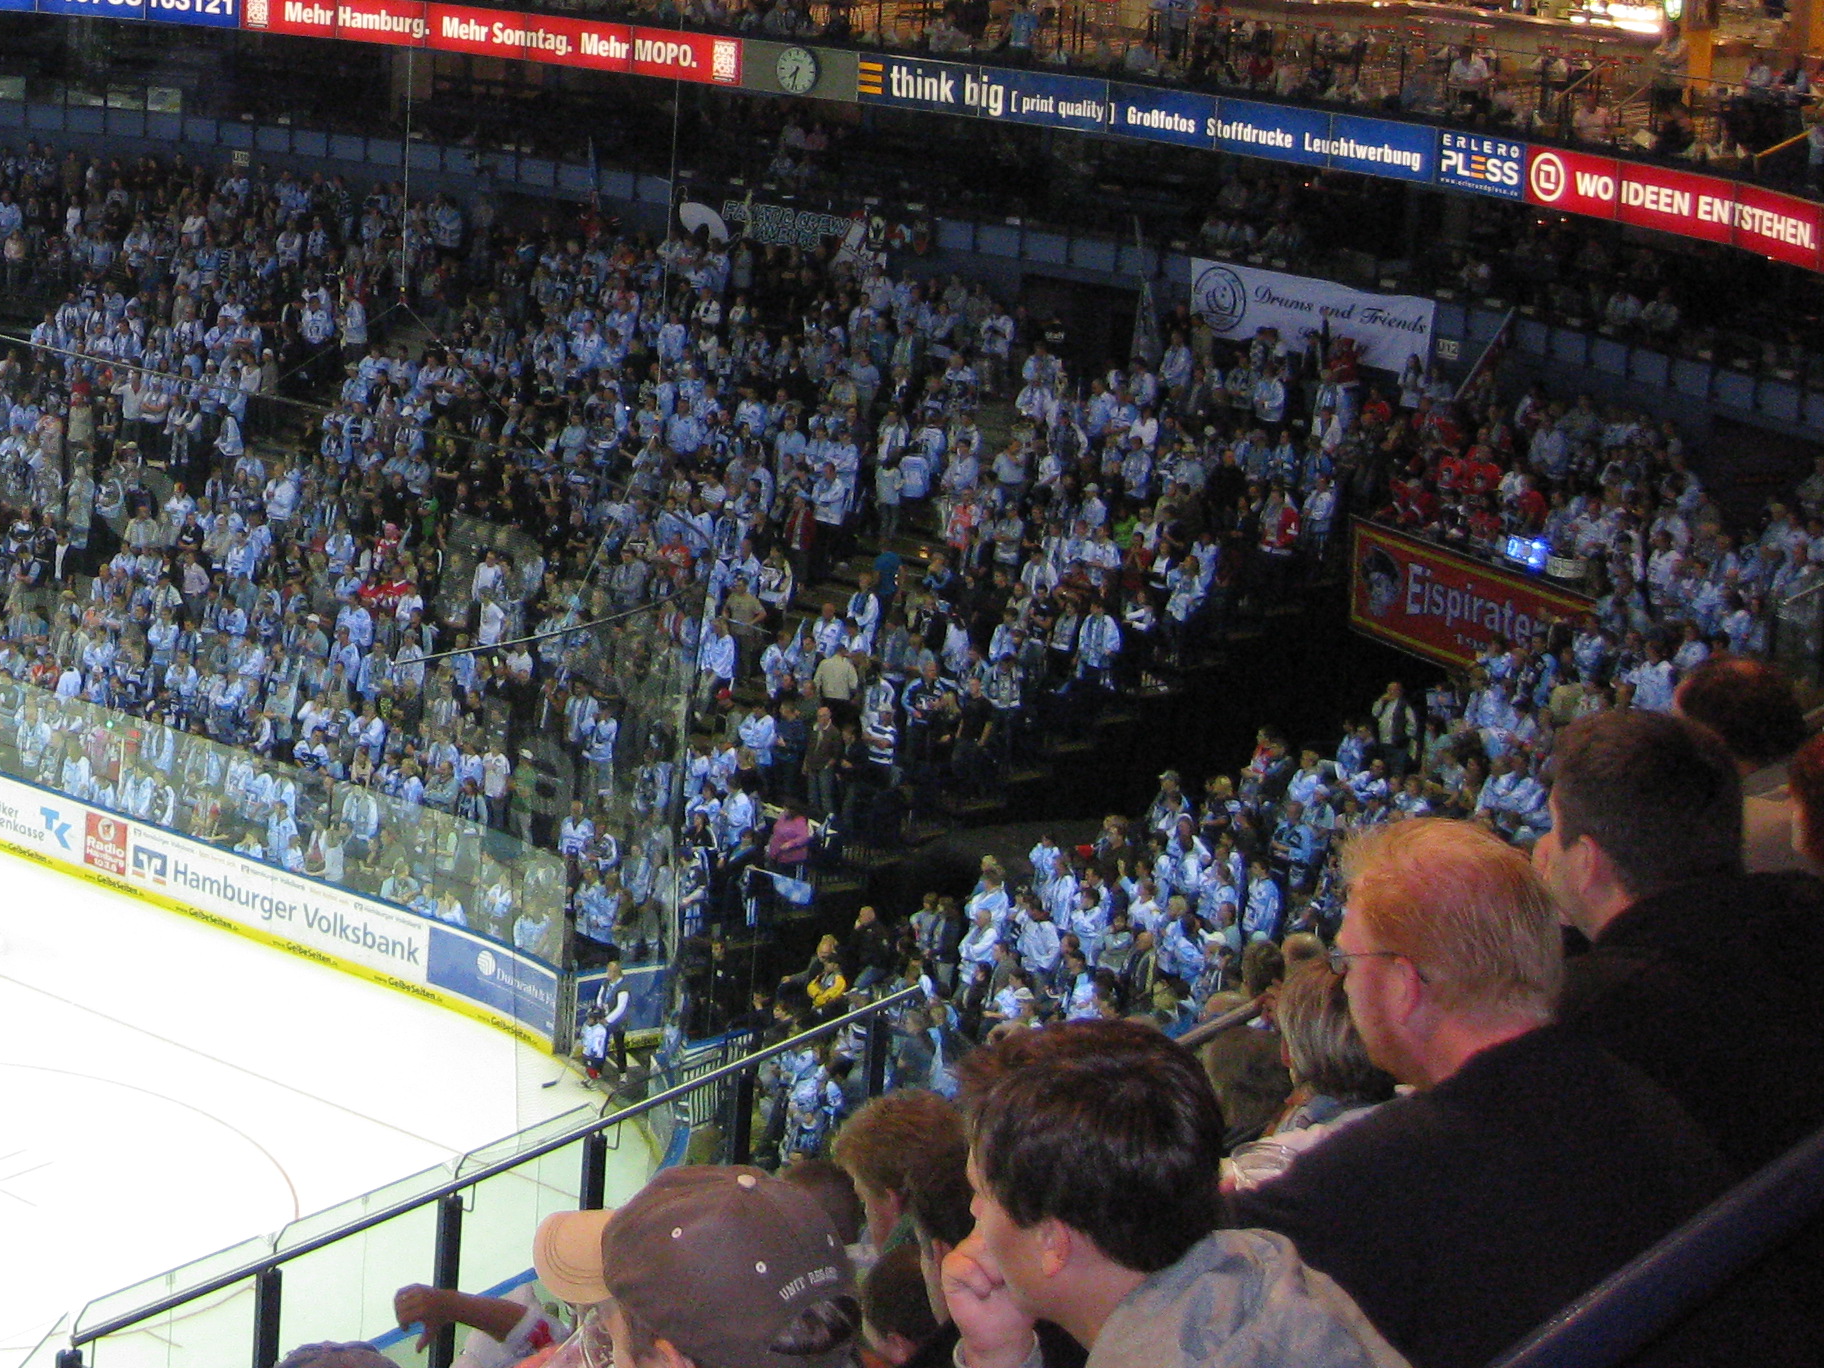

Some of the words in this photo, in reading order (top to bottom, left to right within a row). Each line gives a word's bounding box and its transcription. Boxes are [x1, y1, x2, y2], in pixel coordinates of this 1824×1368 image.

[284, 1, 334, 27] Mehr
[338, 6, 430, 38] Hamburg.
[442, 16, 489, 43] Mehr
[492, 23, 573, 56] Sonntag.
[580, 32, 630, 60] Mehr
[634, 39, 698, 68] MOPO.
[890, 64, 953, 104] think
[964, 73, 1004, 116] big
[1021, 94, 1055, 118] print
[1058, 97, 1105, 123] quality
[1126, 105, 1196, 134] Großfotos
[1206, 118, 1293, 149] Stoffdrucke
[1303, 131, 1422, 172] Leuchtwerbung
[1441, 149, 1519, 186] PLESS
[1575, 171, 1614, 201] WO
[1621, 181, 1690, 217] IDEEN
[1698, 195, 1818, 251] ENTSTEHEN.
[1254, 284, 1314, 313] Drums
[1360, 306, 1426, 334] Friends
[86, 835, 125, 859] Radio
[173, 860, 298, 922] Hamburger
[303, 902, 422, 966] Volksbank
